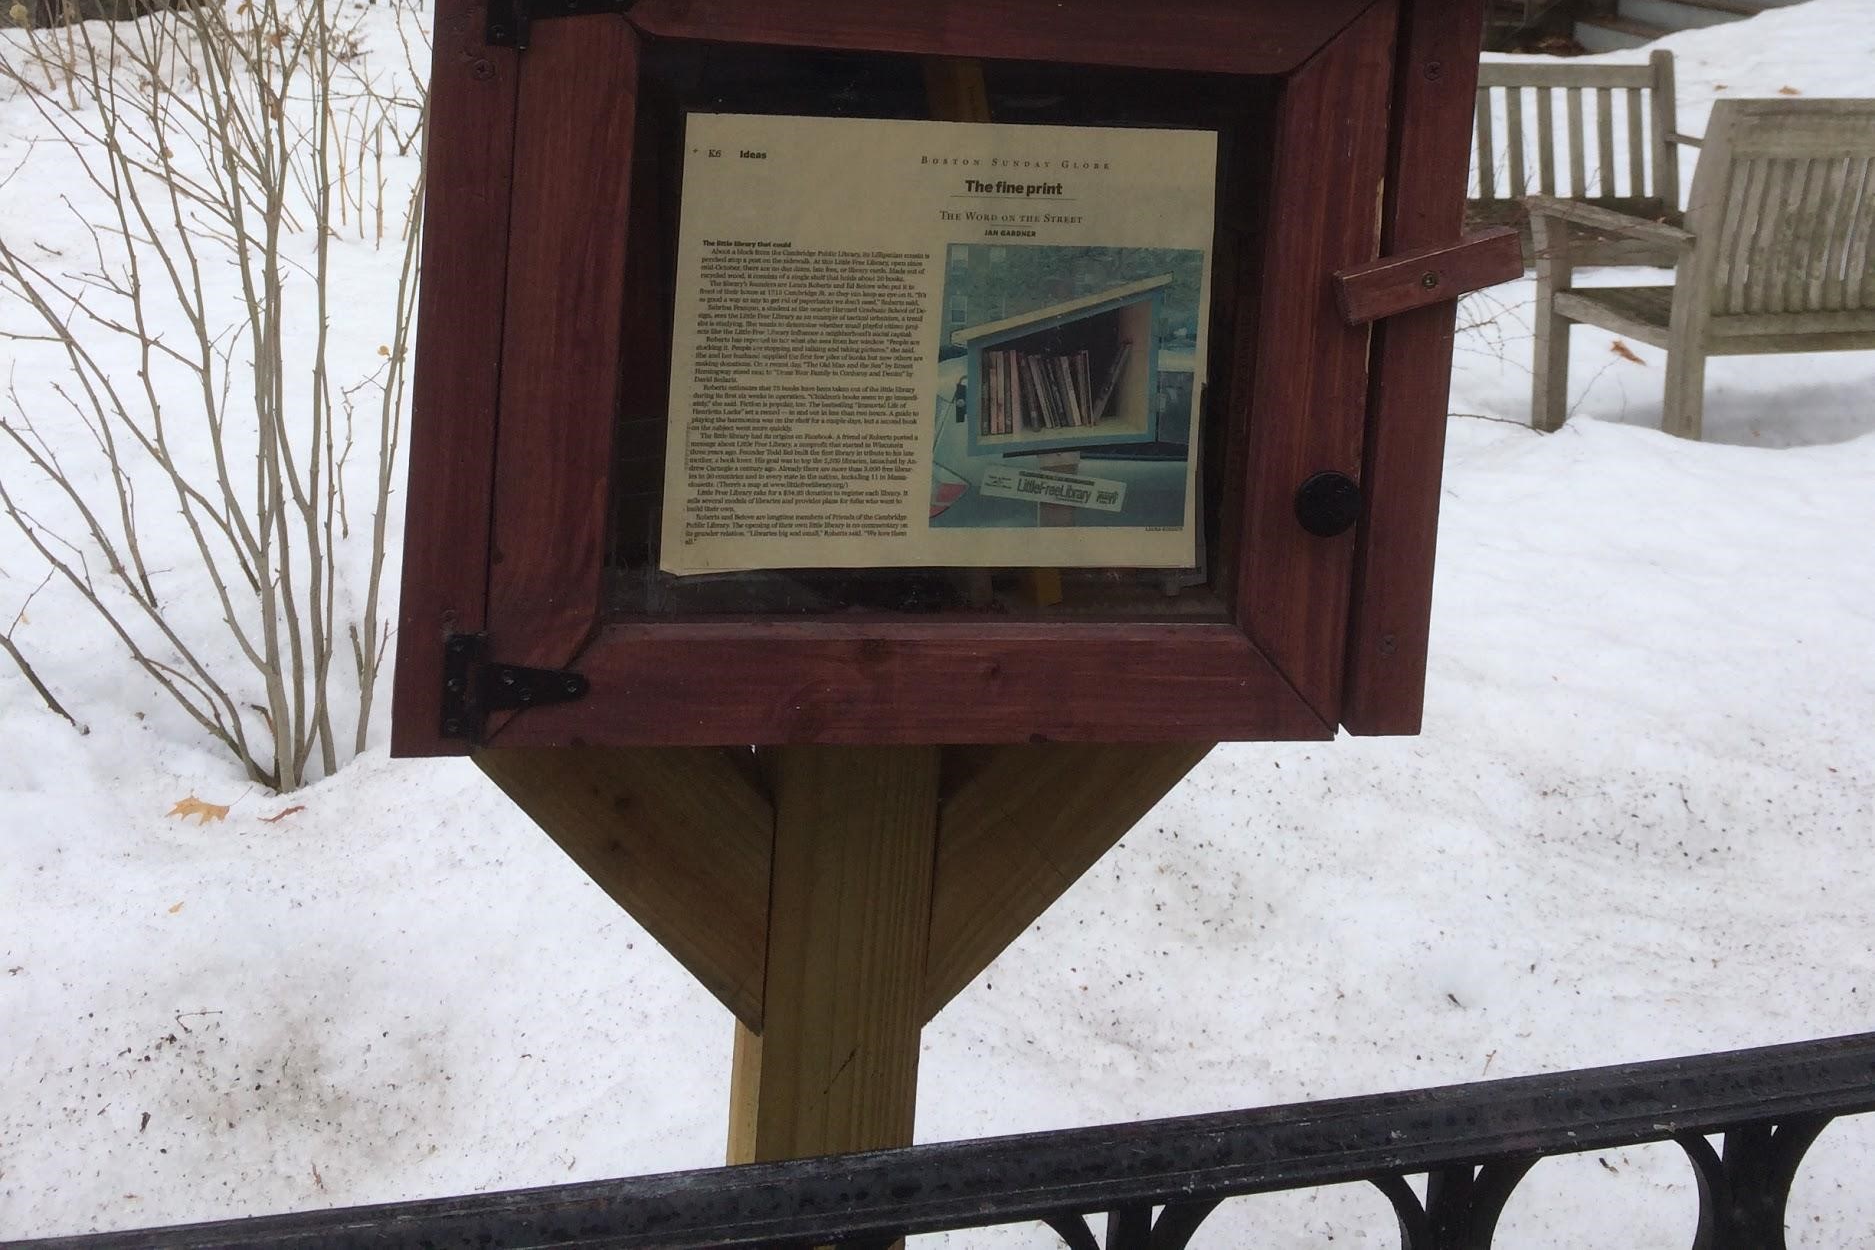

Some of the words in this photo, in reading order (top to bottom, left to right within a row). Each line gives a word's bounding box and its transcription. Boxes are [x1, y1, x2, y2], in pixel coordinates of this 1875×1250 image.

[708, 149, 722, 158] K6
[740, 150, 767, 159] Ideas
[921, 156, 980, 166] BOSTON
[992, 158, 1051, 168] SUNDAY
[1062, 160, 1109, 170] GLOBE
[965, 180, 993, 193] The
[996, 181, 1025, 195] fine
[1027, 183, 1063, 197] print
[940, 210, 961, 221] THE
[966, 212, 999, 222] WORD
[1002, 214, 1016, 222] ON
[1019, 215, 1040, 223] THE
[1044, 214, 1083, 224] STREET
[1000, 230, 1036, 238] GARDNER
[734, 240, 756, 248] library
[1017, 477, 1091, 505] LittleFreeLibrary
